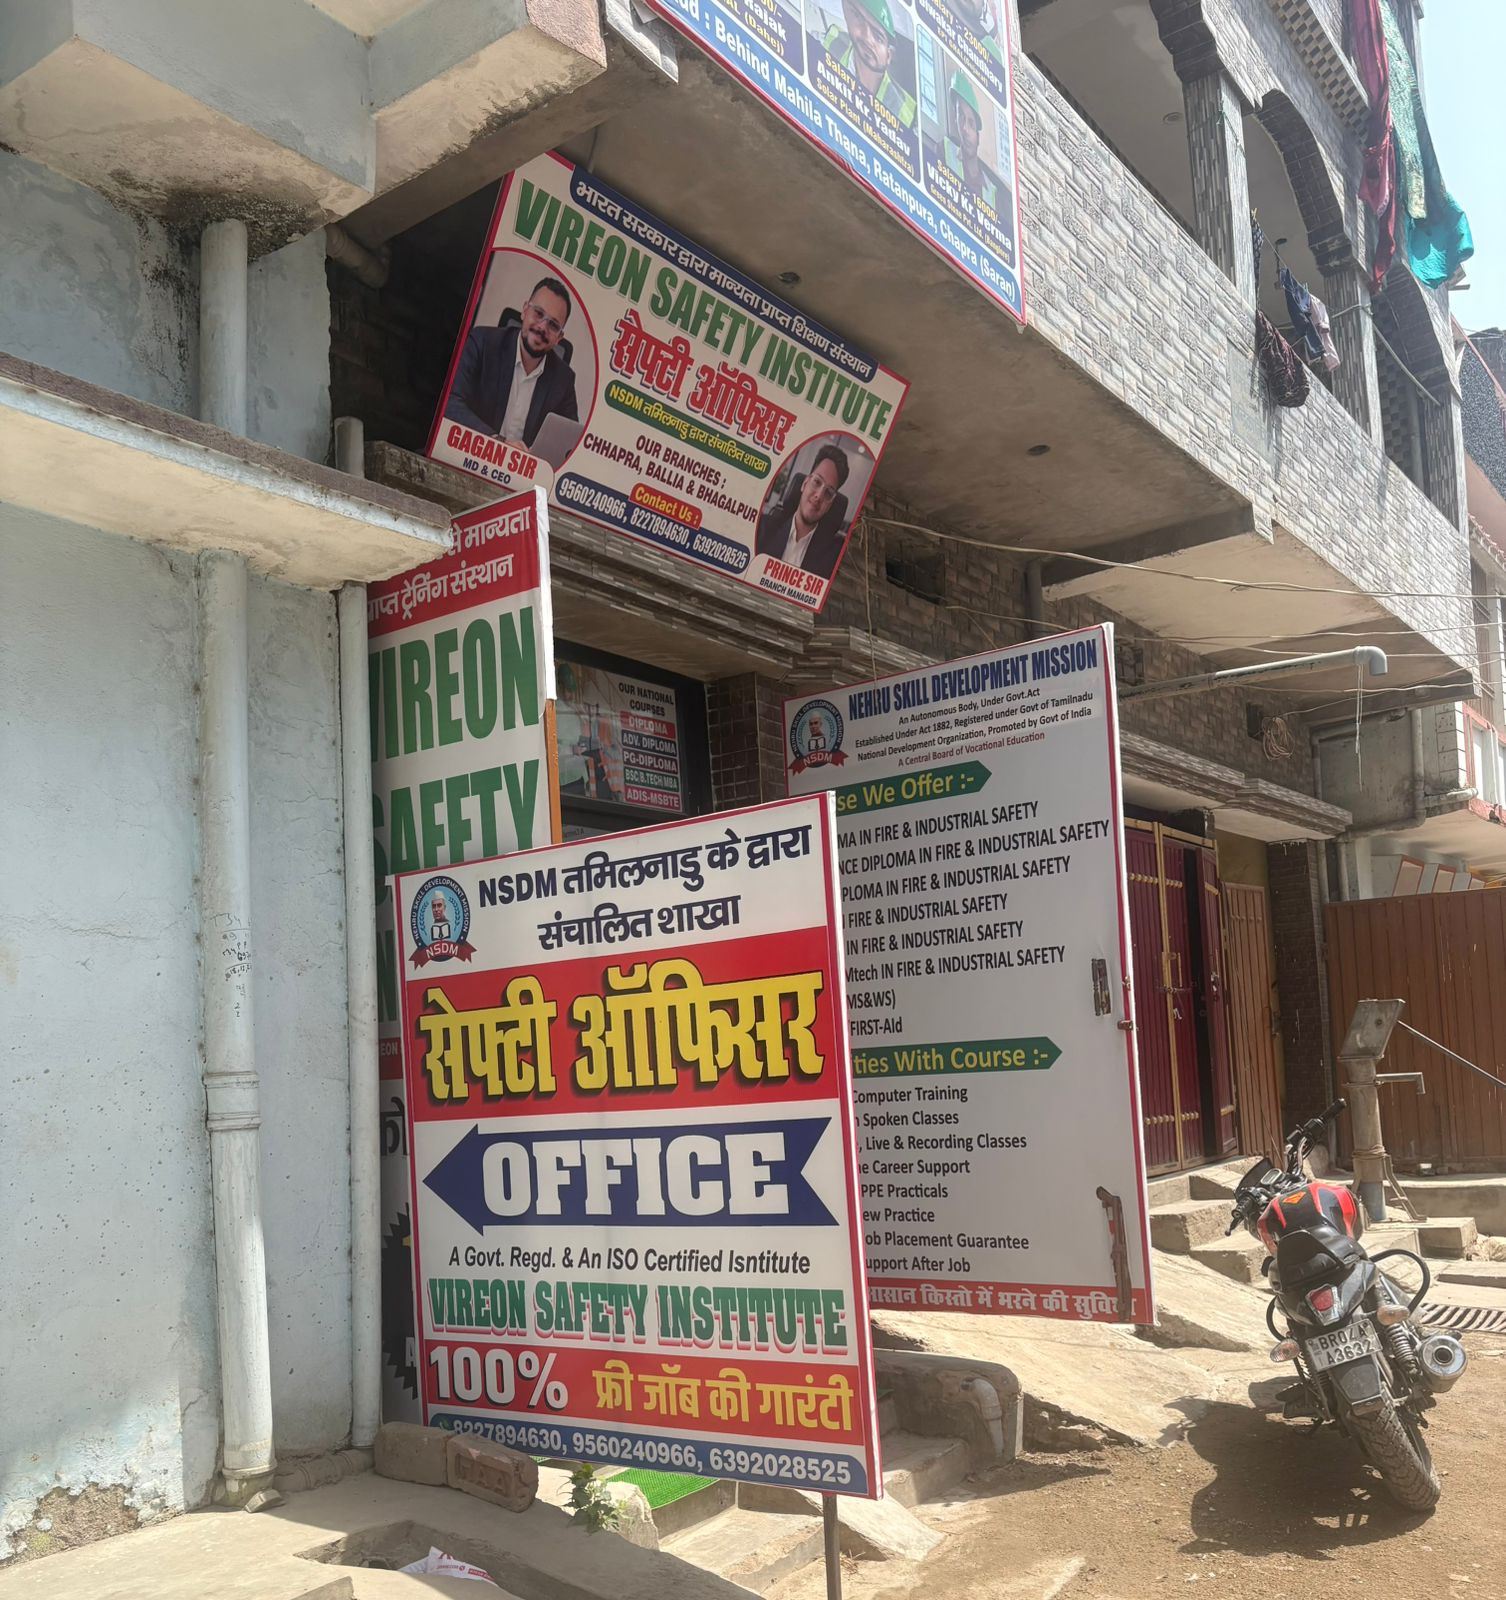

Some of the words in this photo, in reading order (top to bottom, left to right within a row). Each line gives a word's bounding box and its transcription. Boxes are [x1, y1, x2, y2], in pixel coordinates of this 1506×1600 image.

[825, 52, 856, 91] Salary
[817, 60, 853, 104] Ankit
[854, 94, 872, 121] Kr.
[873, 112, 911, 157] Yadav
[714, 15, 771, 83] Behind
[774, 68, 823, 128] Mahila
[824, 114, 871, 175] Thana,
[873, 157, 938, 234] Ratanpura,
[939, 218, 978, 266] Chapra
[980, 254, 1015, 303] (Saran)
[937, 159, 962, 192] Salary
[926, 161, 959, 203] Vicky
[960, 193, 976, 218] Kr.
[976, 208, 1012, 252] Verma
[576, 180, 624, 221] भारत
[622, 208, 679, 257] सरकार
[708, 265, 763, 310] मान्यता
[760, 297, 793, 329] प्राप्त
[791, 315, 831, 353] शिक्षण
[828, 342, 872, 378] संस्थान
[513, 178, 652, 304] VIREON
[649, 266, 765, 366] SAFETY
[759, 332, 892, 442] INSTITUTE
[686, 360, 798, 456] ऑफिसर
[609, 384, 644, 411] NSDM
[642, 401, 690, 441] तमिलनाडु
[706, 433, 745, 463] संचालित
[743, 452, 769, 473] शाखा
[446, 424, 508, 469] GAGAN
[507, 450, 539, 481] SIR
[462, 457, 479, 472] MD
[490, 469, 512, 485] CEO
[635, 434, 661, 460] OUR
[661, 446, 721, 487] BRANCHES
[583, 433, 643, 476] CHHAPRA,
[645, 460, 685, 494] BALLIA
[698, 484, 759, 524] BHAGALPUR
[634, 485, 678, 516] Contact
[464, 506, 531, 549] मान्यता
[558, 477, 628, 524] 9560240966,
[630, 507, 691, 550] 8227894630,
[692, 534, 749, 570] 6392028525
[401, 571, 449, 621] ट्रेनिंग
[449, 553, 515, 595] संस्थान
[759, 577, 786, 596] BRANCH
[786, 586, 817, 607] MANAGER
[763, 557, 804, 589] PRINCE
[804, 574, 825, 597] SIR
[618, 681, 636, 696] OUR
[636, 686, 675, 705] NATIONAL
[849, 686, 891, 721] NEHRU
[893, 677, 930, 711] SKILL
[931, 654, 1030, 704] DEVELOPMENT
[1031, 638, 1099, 682] MISSION
[628, 716, 668, 736] DIPLOMA
[629, 699, 666, 717] COURSES
[855, 732, 895, 749] Established
[954, 711, 993, 728] Registered
[1050, 691, 1094, 708] Tamilnadu
[910, 706, 957, 724] Autonomous
[641, 736, 677, 755] DIPLOMA
[857, 747, 887, 762] National
[887, 737, 936, 757] Development
[937, 728, 987, 747] Organization,
[987, 718, 1026, 735] Promoted
[1071, 706, 1092, 719] India
[964, 736, 1005, 754] Vocational
[1006, 730, 1045, 747] Education
[623, 750, 678, 773] PG-DIPLOMA
[626, 788, 680, 808] ADIS-MSBTE
[862, 785, 895, 805] We
[901, 772, 954, 801] Offer
[874, 823, 899, 843] FIRE
[915, 809, 989, 837] INDUSTRIAL
[991, 800, 1039, 824] SAFETY
[861, 849, 917, 873] DIPLOMA
[935, 841, 962, 862] FIRE
[978, 827, 1057, 855] INDUSTRIAL
[1059, 819, 1110, 843] SAFETY
[478, 867, 557, 909] NSDM
[561, 849, 705, 895] तमिलनाडु
[706, 828, 746, 872] के
[745, 824, 813, 870] द्वारा
[902, 875, 927, 895] FIRE
[943, 861, 1020, 889] INDUSTRIAL
[1022, 855, 1072, 879] SAFETY
[537, 902, 655, 952] संचालित
[657, 894, 742, 935] शाखा
[848, 909, 872, 929] FIRE
[887, 897, 960, 923] INDUSTRIAL
[961, 892, 1008, 915] SAFETY
[425, 942, 459, 959] NSDM
[861, 935, 886, 954] FIRE
[901, 924, 974, 950] INDUSTRIAL
[976, 920, 1024, 941] SAFETY
[896, 959, 922, 978] FIRE
[938, 950, 1014, 974] INDUSTRIAL
[1016, 945, 1066, 967] SAFETY
[571, 957, 825, 1092] ऑफिसर
[893, 1049, 945, 1072] With
[950, 1046, 1026, 1069] Course
[914, 1085, 969, 1103] Training
[863, 1111, 909, 1129] Spoken
[911, 1110, 960, 1125] Classes
[865, 1136, 891, 1151] Live
[907, 1134, 974, 1152] Recording
[976, 1133, 1028, 1148] Classes
[482, 1131, 791, 1218] OFFICE
[872, 1159, 914, 1174] Career
[916, 1159, 971, 1176] Support
[887, 1183, 949, 1199] Practicals
[884, 1207, 936, 1223] Practice
[884, 1231, 954, 1248] Placement
[956, 1233, 1030, 1250] Guarantee
[449, 1246, 461, 1268] A
[464, 1246, 506, 1268] Govt.
[509, 1248, 557, 1272] Regd.
[561, 1249, 574, 1270] &
[577, 1249, 603, 1271] An
[606, 1249, 639, 1272] ISO
[643, 1247, 723, 1274] Certified
[727, 1249, 812, 1275] Isntitute
[911, 1256, 945, 1272] After
[947, 1257, 971, 1273] Job
[427, 1276, 528, 1337] VIREON
[534, 1279, 650, 1346] SAFETY
[657, 1285, 850, 1357] INSTITUTE
[1039, 1289, 1069, 1312] की
[429, 1345, 570, 1413] 100%
[592, 1359, 635, 1413] फ्री
[638, 1363, 702, 1420] जॉब
[704, 1367, 752, 1424] की
[754, 1373, 855, 1433] गारंटी
[572, 1433, 704, 1474] 9560240966,
[708, 1447, 852, 1485] 6392028525
